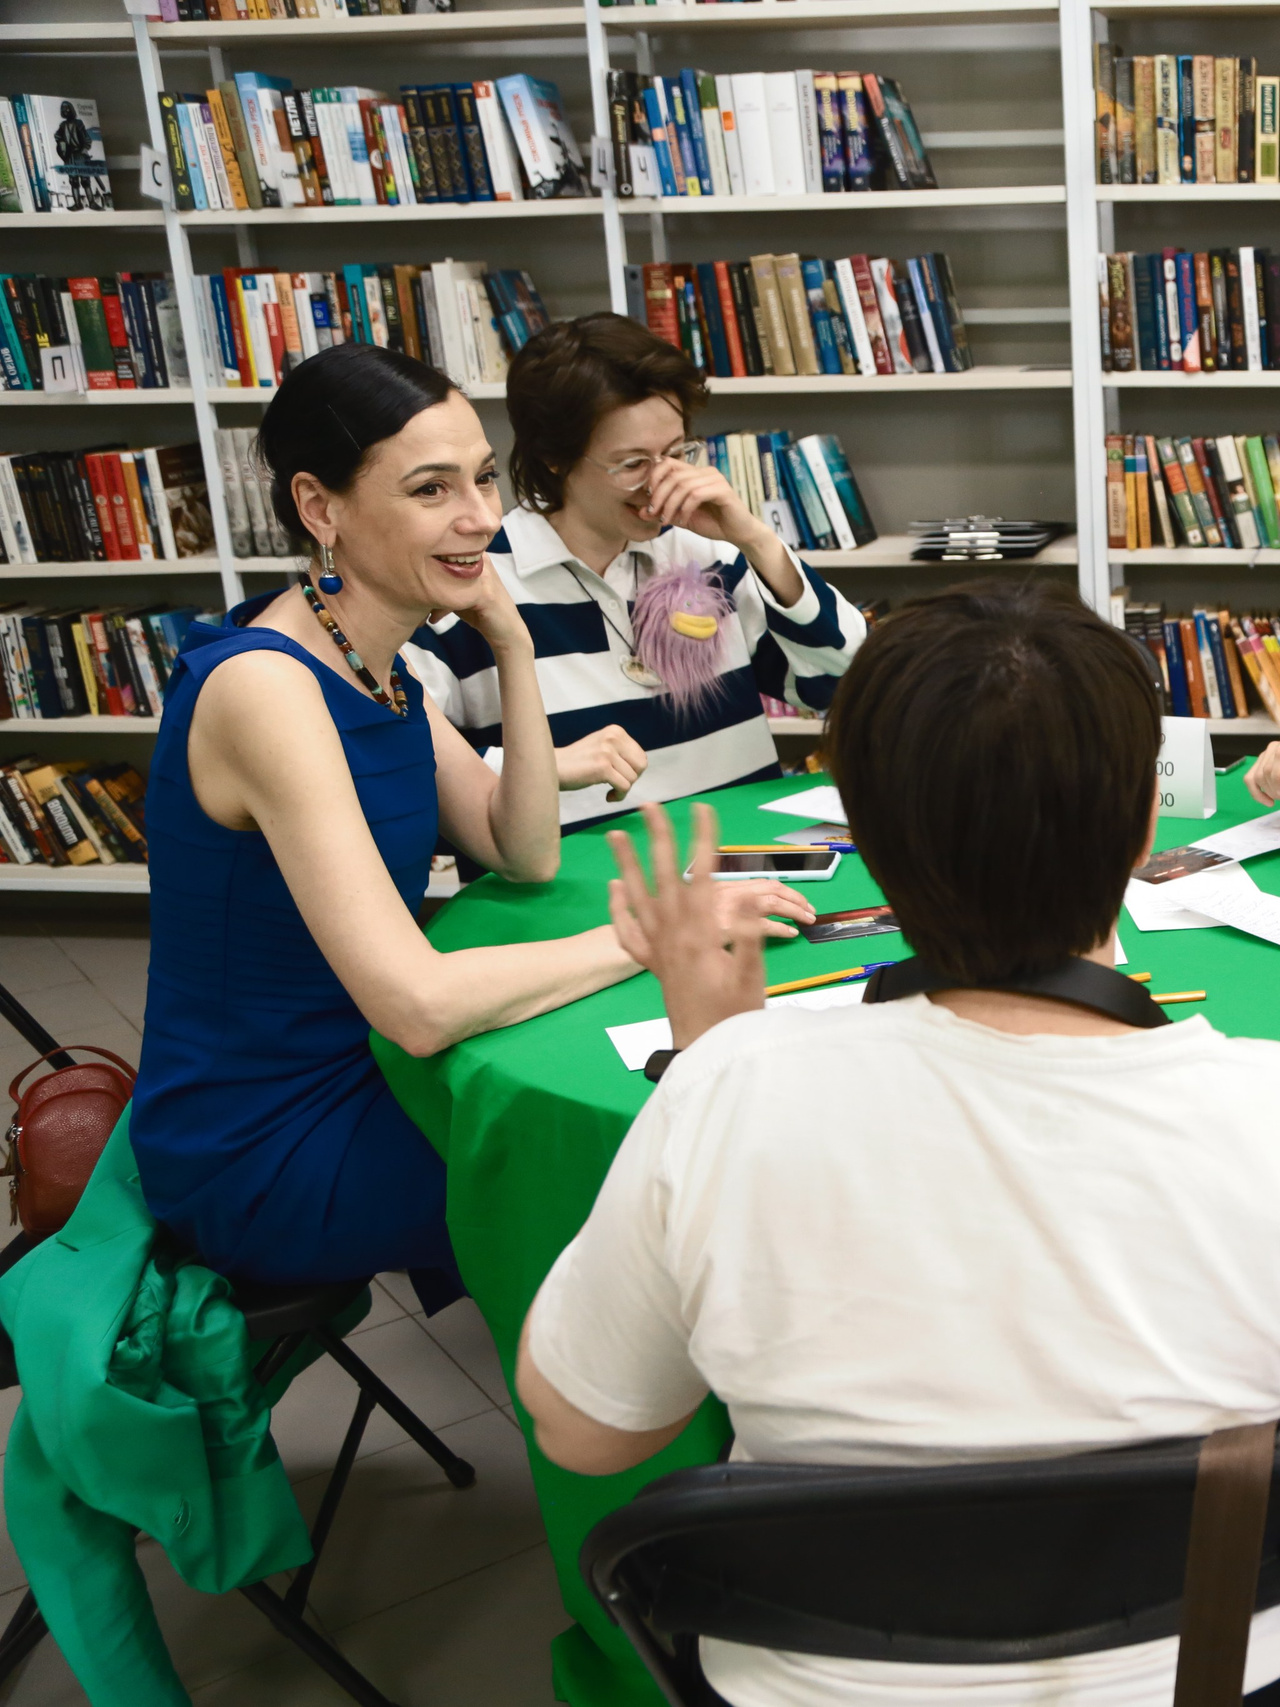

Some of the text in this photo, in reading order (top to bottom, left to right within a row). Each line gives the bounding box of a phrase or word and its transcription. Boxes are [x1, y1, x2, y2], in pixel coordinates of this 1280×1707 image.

[285, 94, 302, 136] ПЕТЛЯ
[301, 89, 319, 137] НАПРЯЖЕНИЕ
[152, 161, 162, 187] С
[1, 347, 17, 376] ОРЛОВ
[51, 355, 66, 380] П
[44, 798, 80, 845] ШОЛОХОВ
